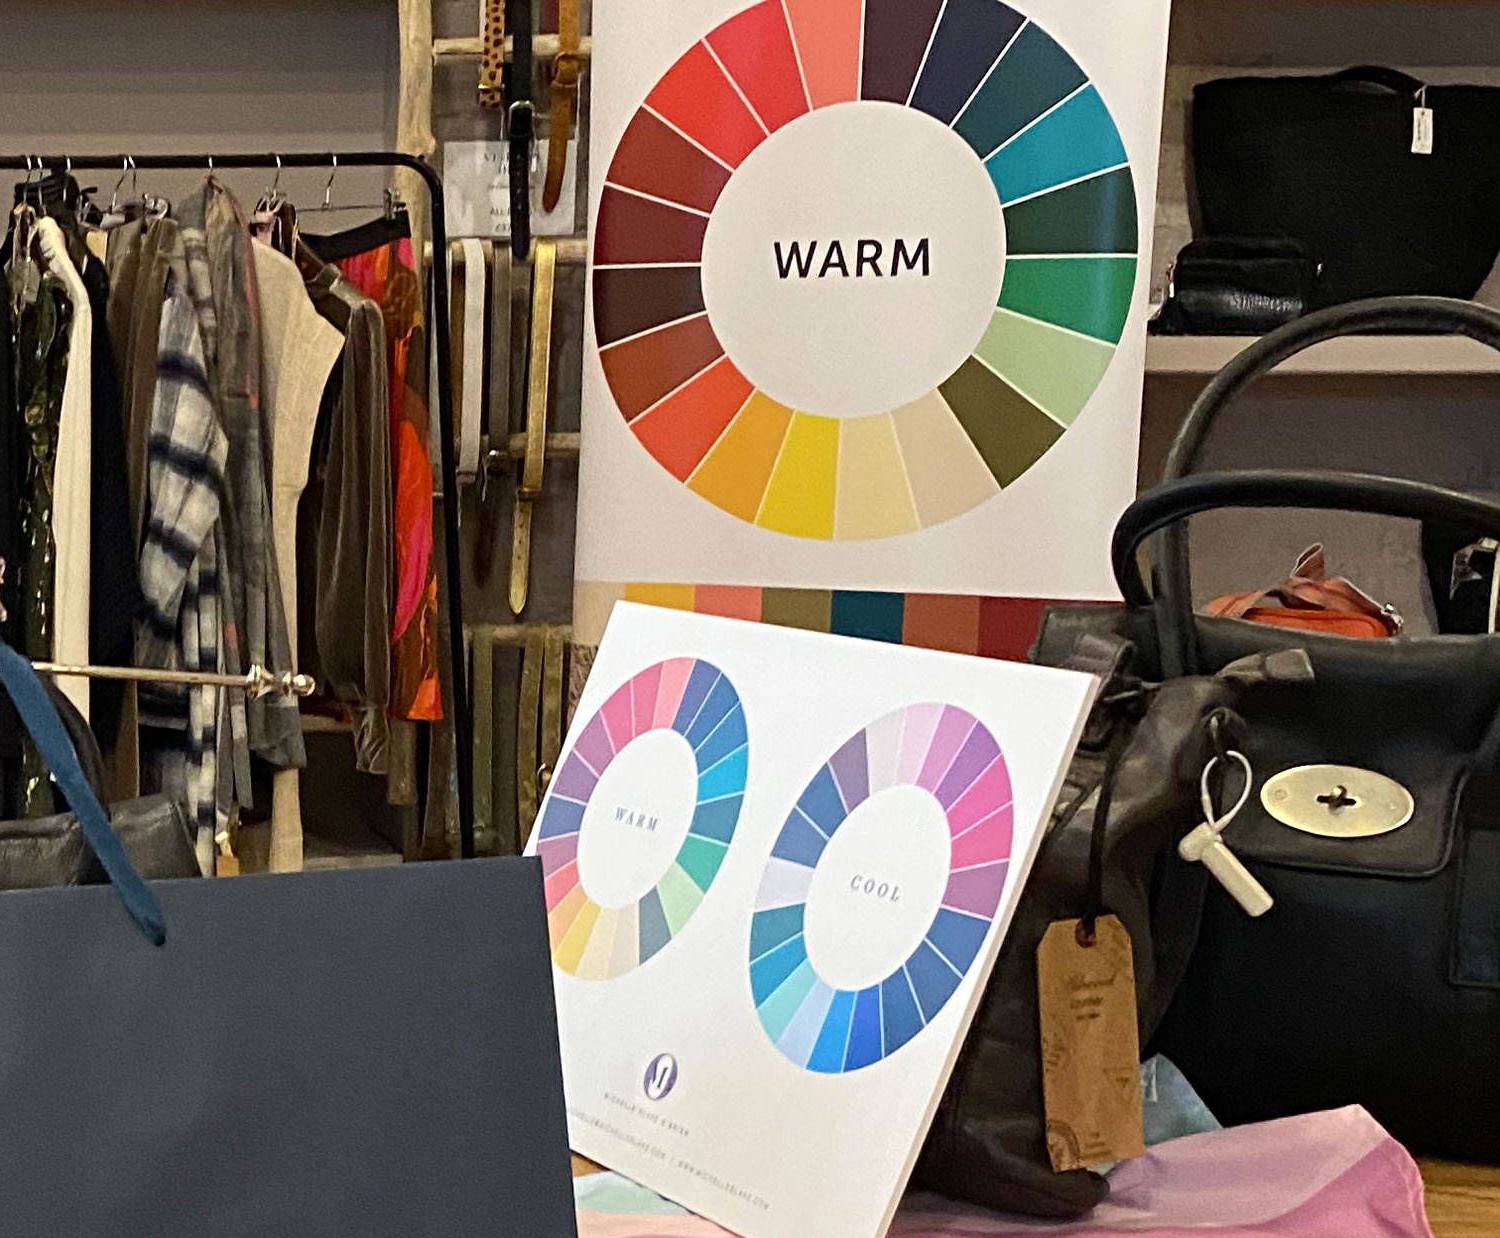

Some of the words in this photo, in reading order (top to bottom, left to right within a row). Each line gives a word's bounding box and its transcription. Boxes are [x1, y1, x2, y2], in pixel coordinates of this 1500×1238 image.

[773, 237, 930, 279] WARM
[614, 806, 659, 832] WARM
[850, 874, 900, 902] COOL
